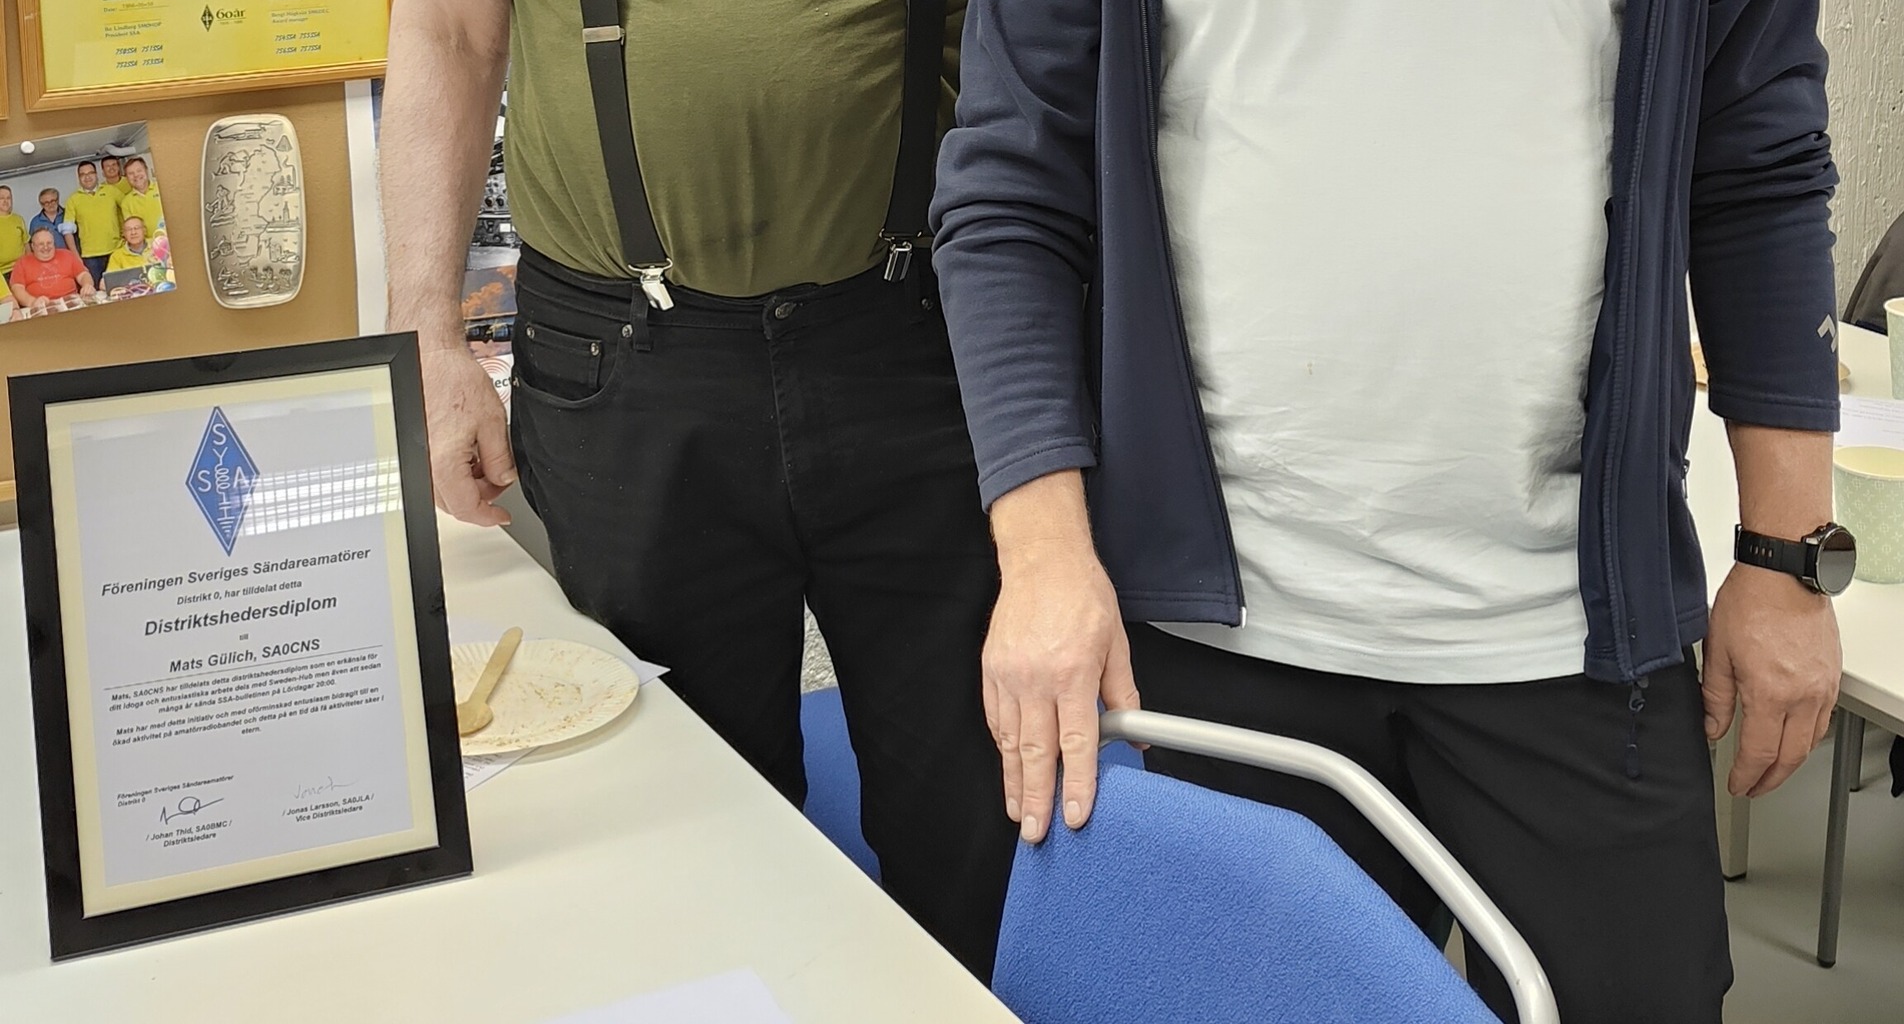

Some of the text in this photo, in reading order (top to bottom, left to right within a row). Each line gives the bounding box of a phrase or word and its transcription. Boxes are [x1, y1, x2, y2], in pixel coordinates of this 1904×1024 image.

[101, 548, 371, 596] Föreningen Sveriges Sändareamatörer
[177, 591, 212, 605] Distrikt
[224, 589, 240, 598] har
[242, 583, 277, 596] tilldelat
[278, 580, 303, 591] detta
[145, 596, 337, 636] Distriktshedersdiplom
[239, 633, 249, 641] till
[169, 639, 321, 673] Mats Gülich, SA0CNS
[109, 704, 122, 712] ditt
[123, 701, 144, 710] idoga
[161, 690, 209, 704] entusiastiska
[210, 687, 234, 696] arbete
[235, 683, 250, 692] dels
[251, 680, 268, 689] med
[268, 672, 314, 686] Sweden-Hub
[314, 670, 330, 679] men
[331, 667, 349, 676] även
[360, 661, 382, 672] sedan
[111, 694, 131, 702] Mats,
[133, 687, 164, 698] SA0CNS
[165, 684, 178, 693] har
[179, 680, 210, 691] tilldelats
[211, 677, 230, 686] detta
[231, 664, 309, 682] distriktshedersdiplom
[310, 662, 326, 670] som
[336, 654, 367, 666] erkänsla
[367, 653, 378, 661] för
[158, 683, 315, 714] många sända SSA-bulletinen på Lördagar
[112, 695, 381, 746] ökad aktivitet på amatörradiobandet och detta på aktiviteter sker
[116, 727, 134, 736] Mats
[135, 724, 149, 733] har
[149, 721, 166, 730] med
[167, 718, 186, 727] detta
[187, 714, 214, 724] initiativ
[215, 711, 229, 719] och
[230, 708, 247, 717] med
[248, 700, 293, 714] oförminskad
[294, 694, 330, 706] entusiasm
[241, 726, 262, 735] etern.
[287, 806, 308, 816] Jonas
[150, 831, 174, 841] Johan
[163, 832, 217, 847] Distriktsledare
